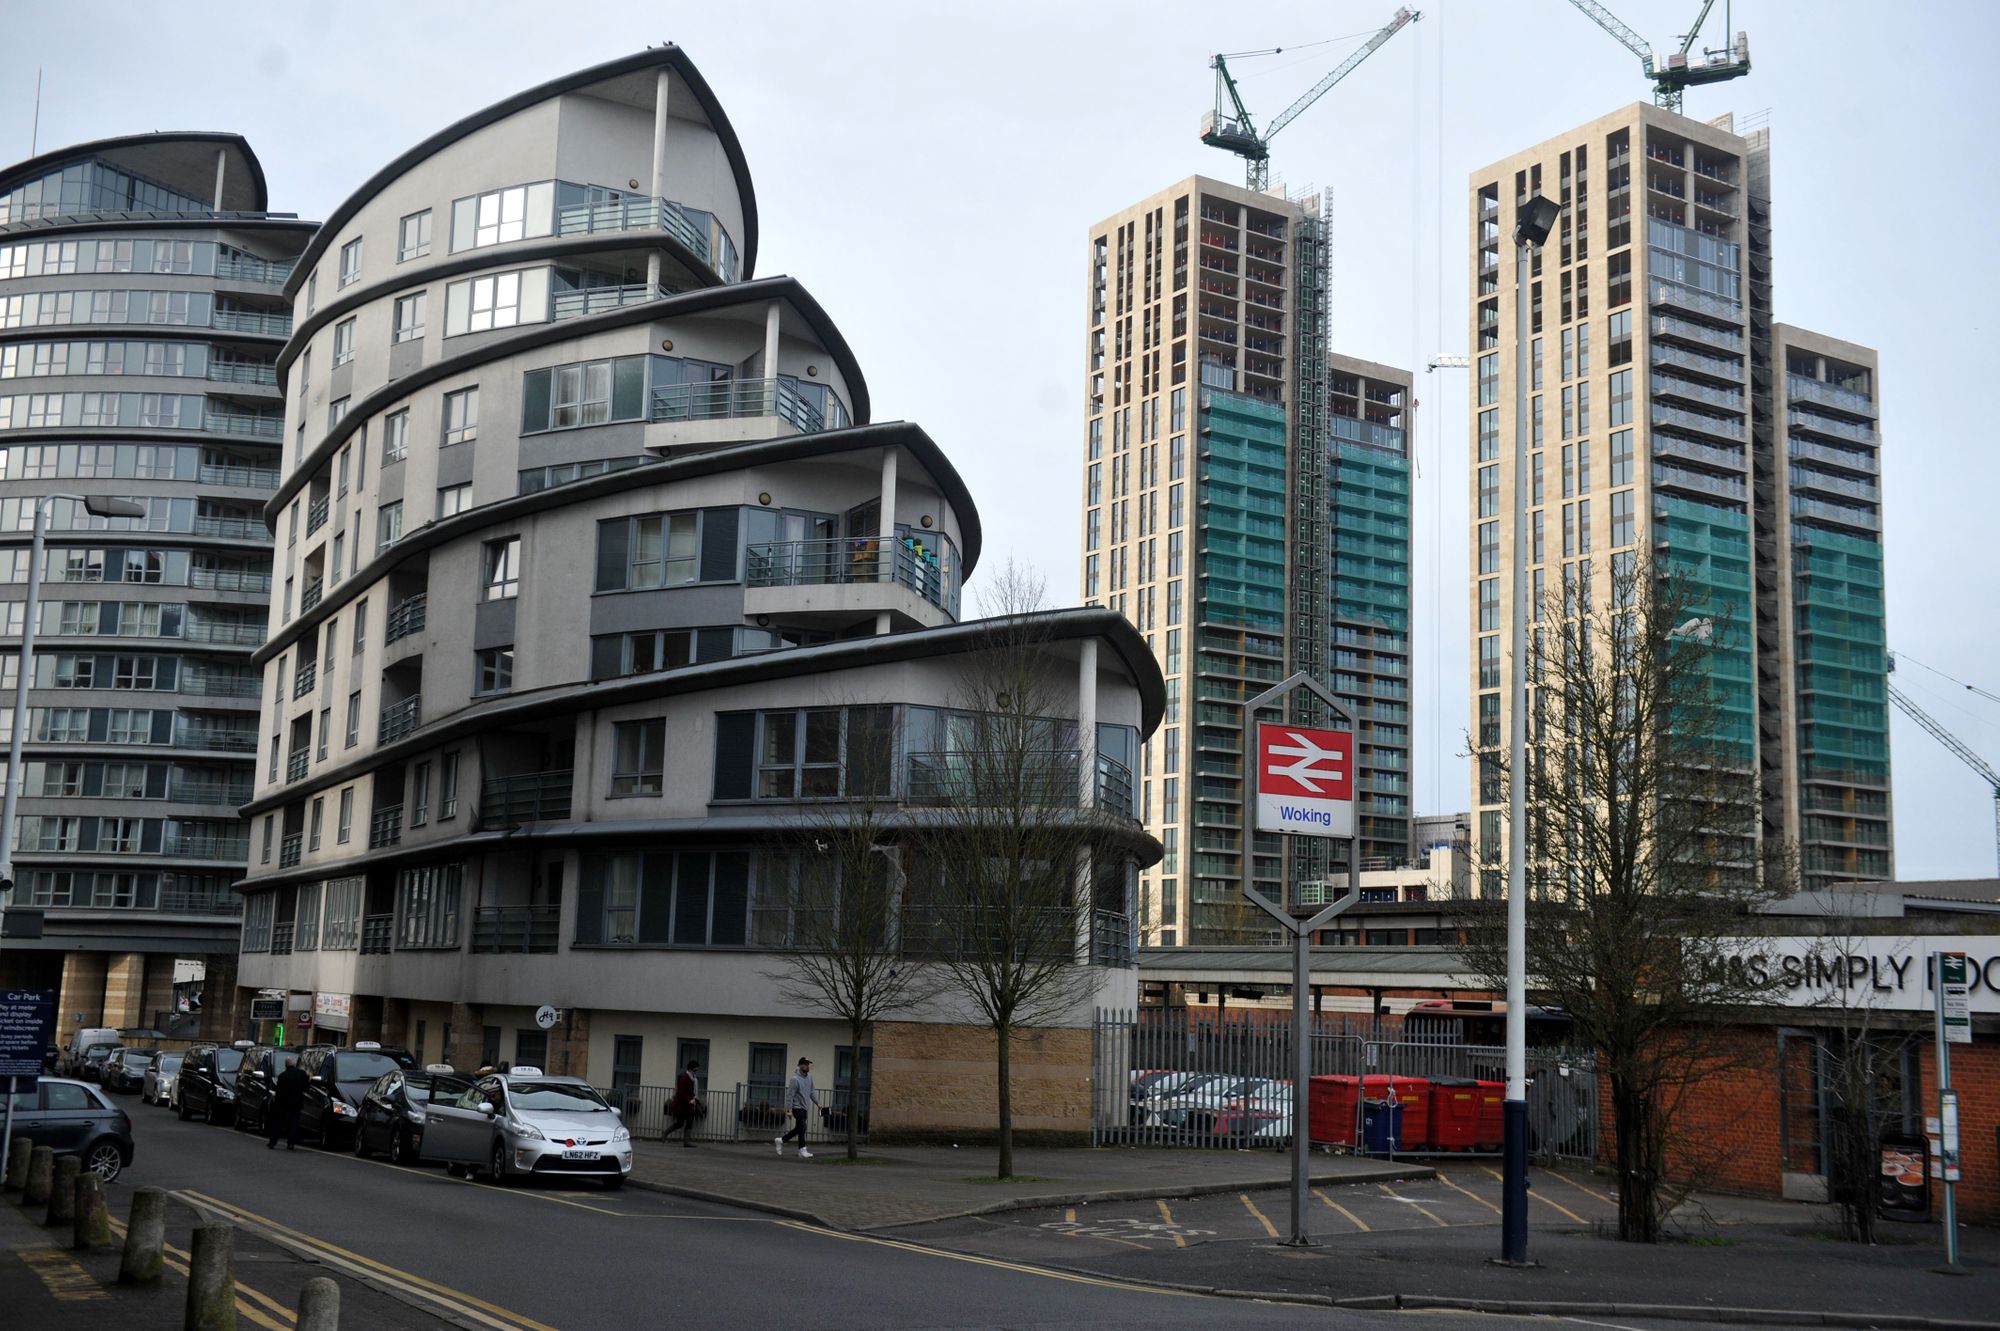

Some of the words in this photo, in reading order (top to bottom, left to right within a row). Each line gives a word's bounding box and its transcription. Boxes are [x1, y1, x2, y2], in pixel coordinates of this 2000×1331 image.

[1280, 806, 1331, 826] Woking
[1781, 954, 1913, 991] SIMPLY
[7, 992, 22, 1001] Car
[23, 993, 41, 1001] Park
[564, 1150, 583, 1159] LN62
[584, 1151, 600, 1160] HFZ
